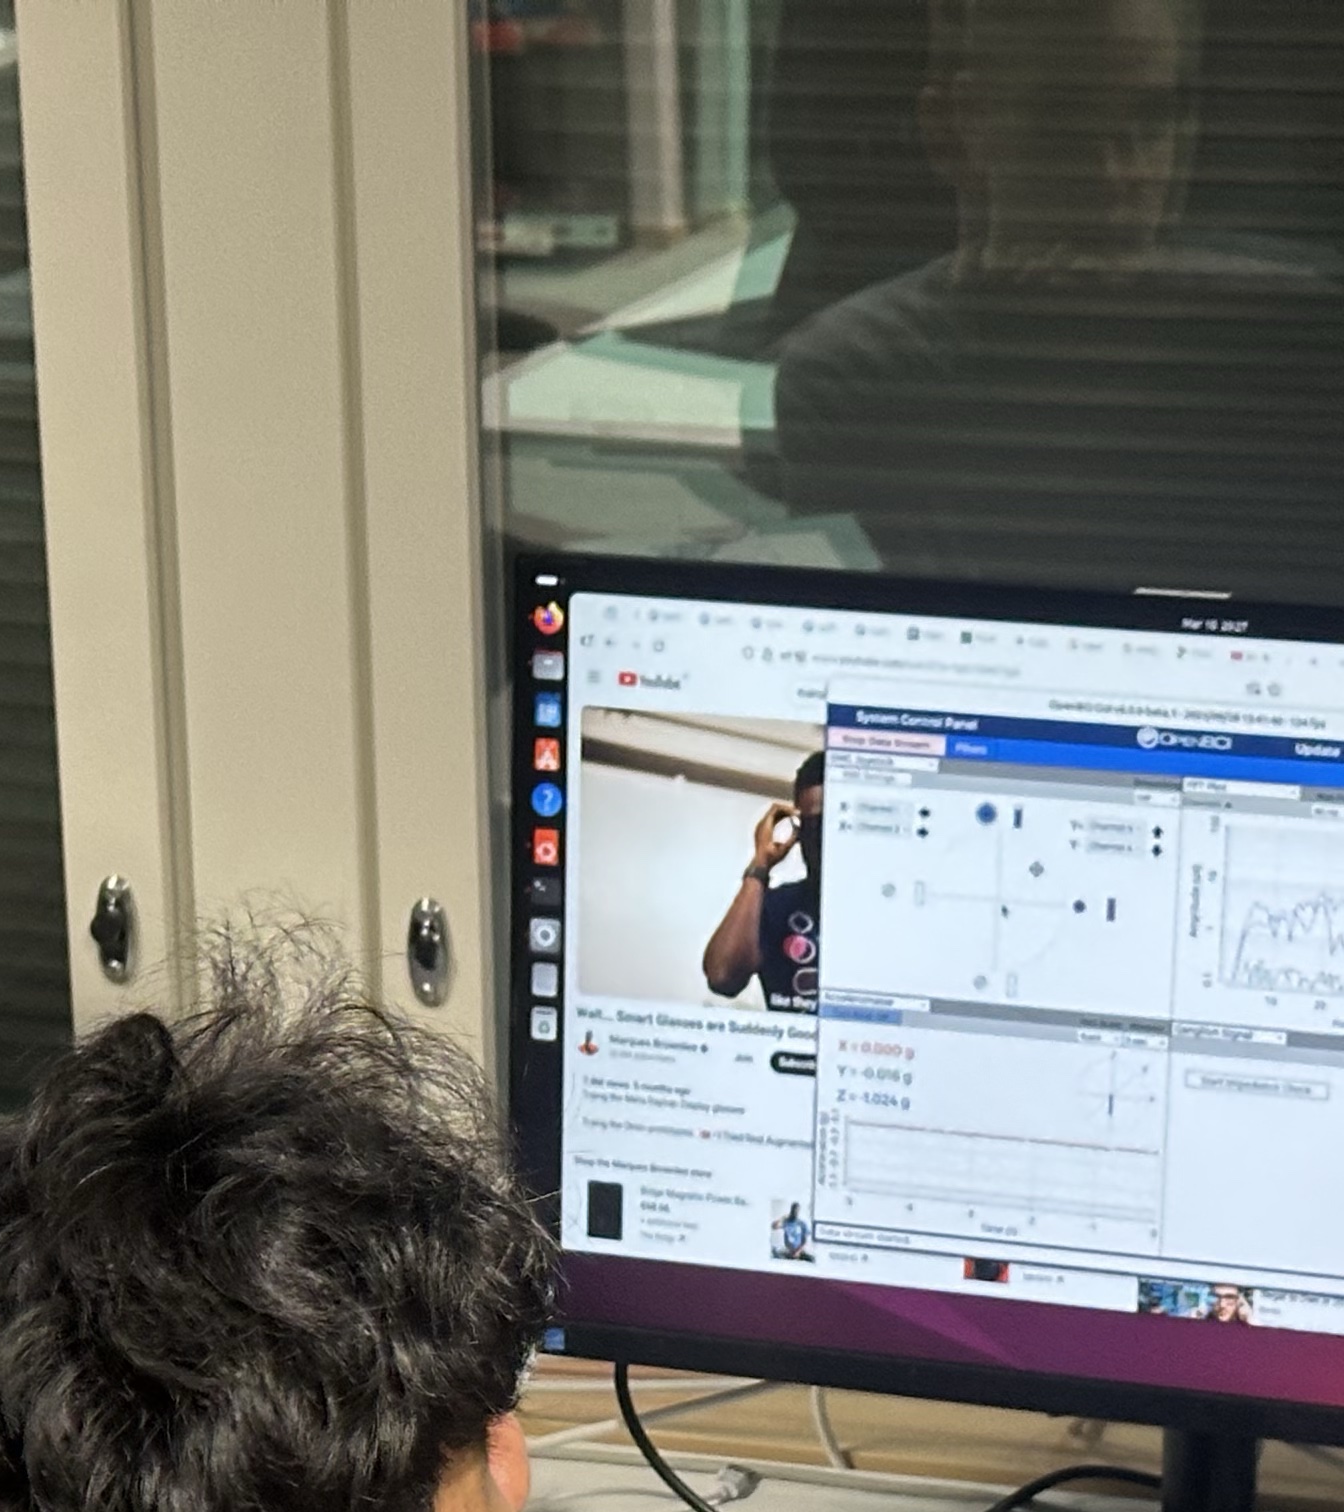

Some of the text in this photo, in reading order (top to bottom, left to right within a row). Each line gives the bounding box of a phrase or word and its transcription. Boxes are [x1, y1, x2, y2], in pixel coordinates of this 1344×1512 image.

[856, 710, 979, 731] System Control Panel
[1295, 742, 1341, 759] Update
[616, 1009, 653, 1025] Smart
[655, 1012, 704, 1030] Glasses
[706, 1019, 726, 1033] are
[728, 1020, 785, 1040] Suddenly
[837, 1065, 847, 1077] Y
[837, 1089, 846, 1102] Z
